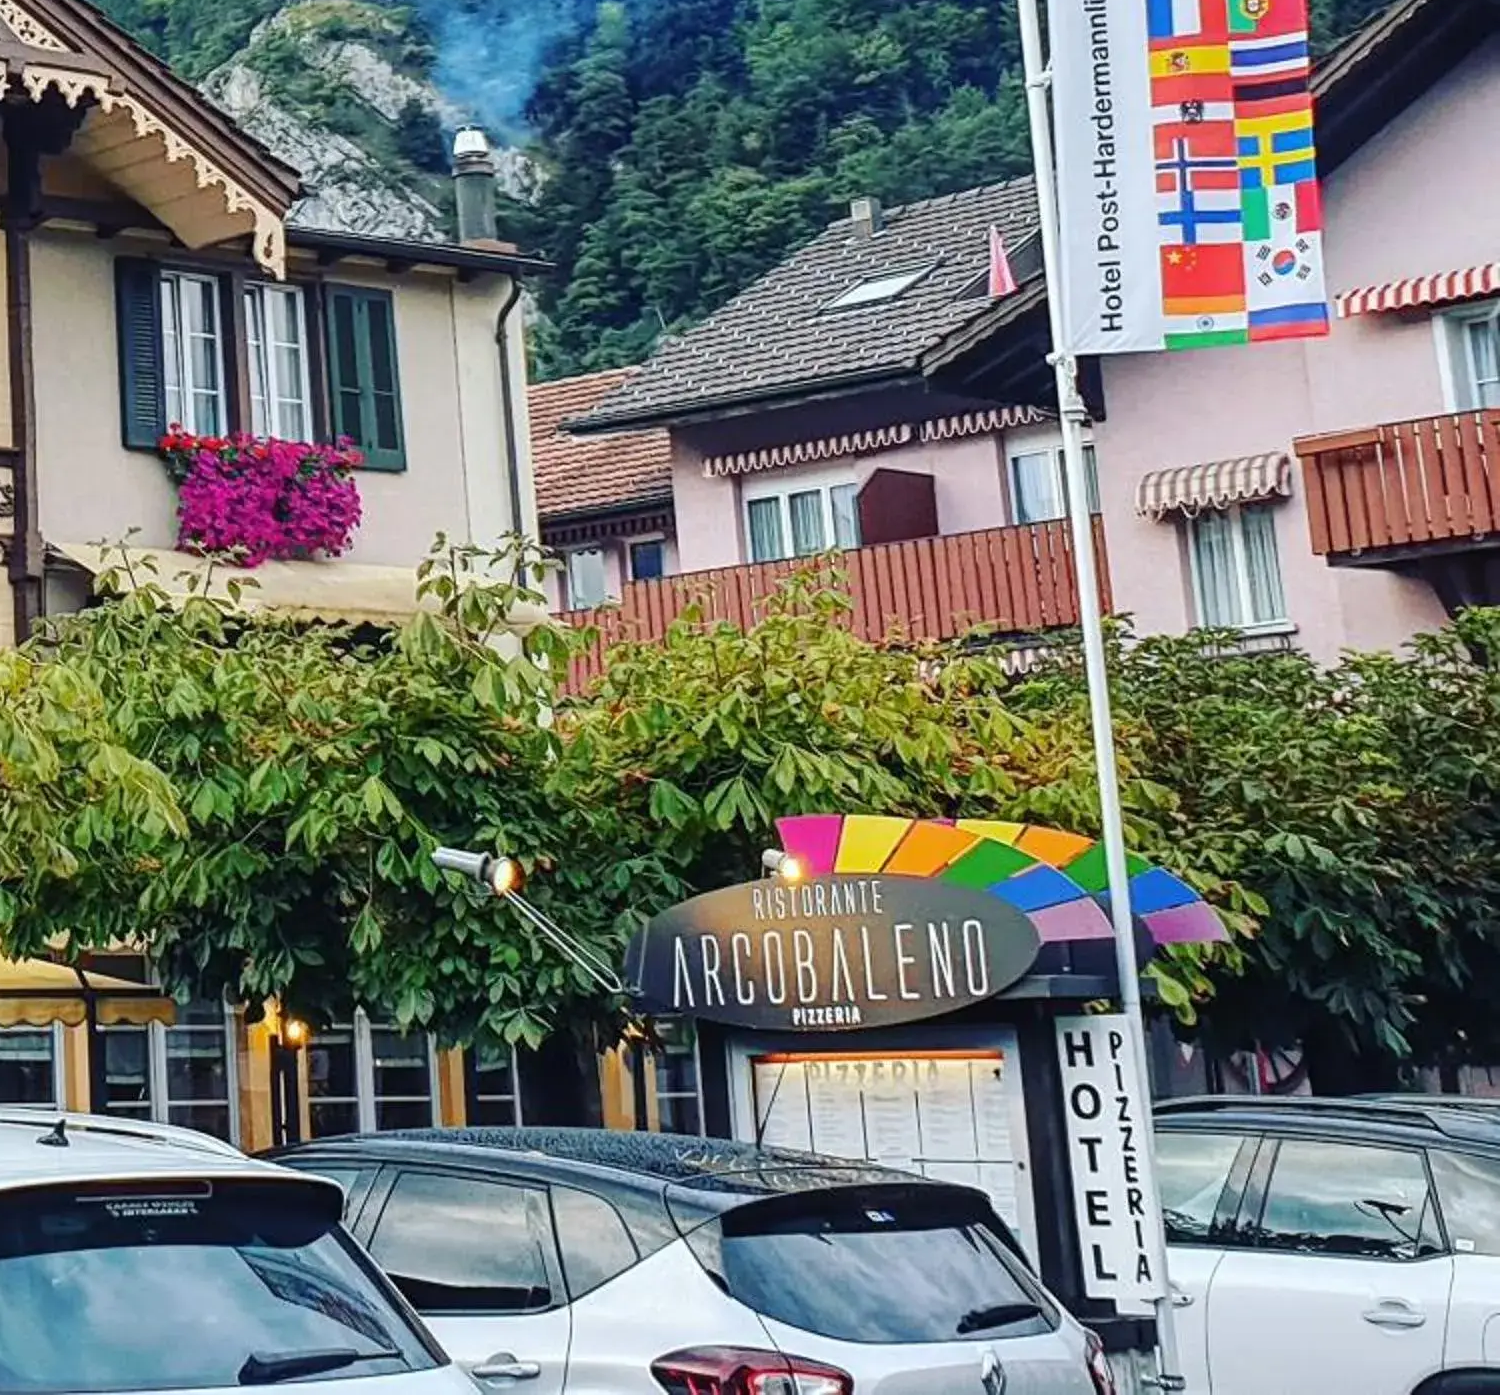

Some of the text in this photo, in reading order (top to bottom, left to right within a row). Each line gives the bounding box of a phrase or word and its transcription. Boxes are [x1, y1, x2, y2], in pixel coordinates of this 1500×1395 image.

[1098, 259, 1124, 333] Hotel
[753, 880, 884, 921] RISTORANTE
[673, 919, 990, 1008] ARCOBALENO
[792, 1005, 862, 1027] PIZZERIA
[1063, 1030, 1118, 1281] HOTEL
[1108, 1030, 1153, 1284] PIZZERIA
